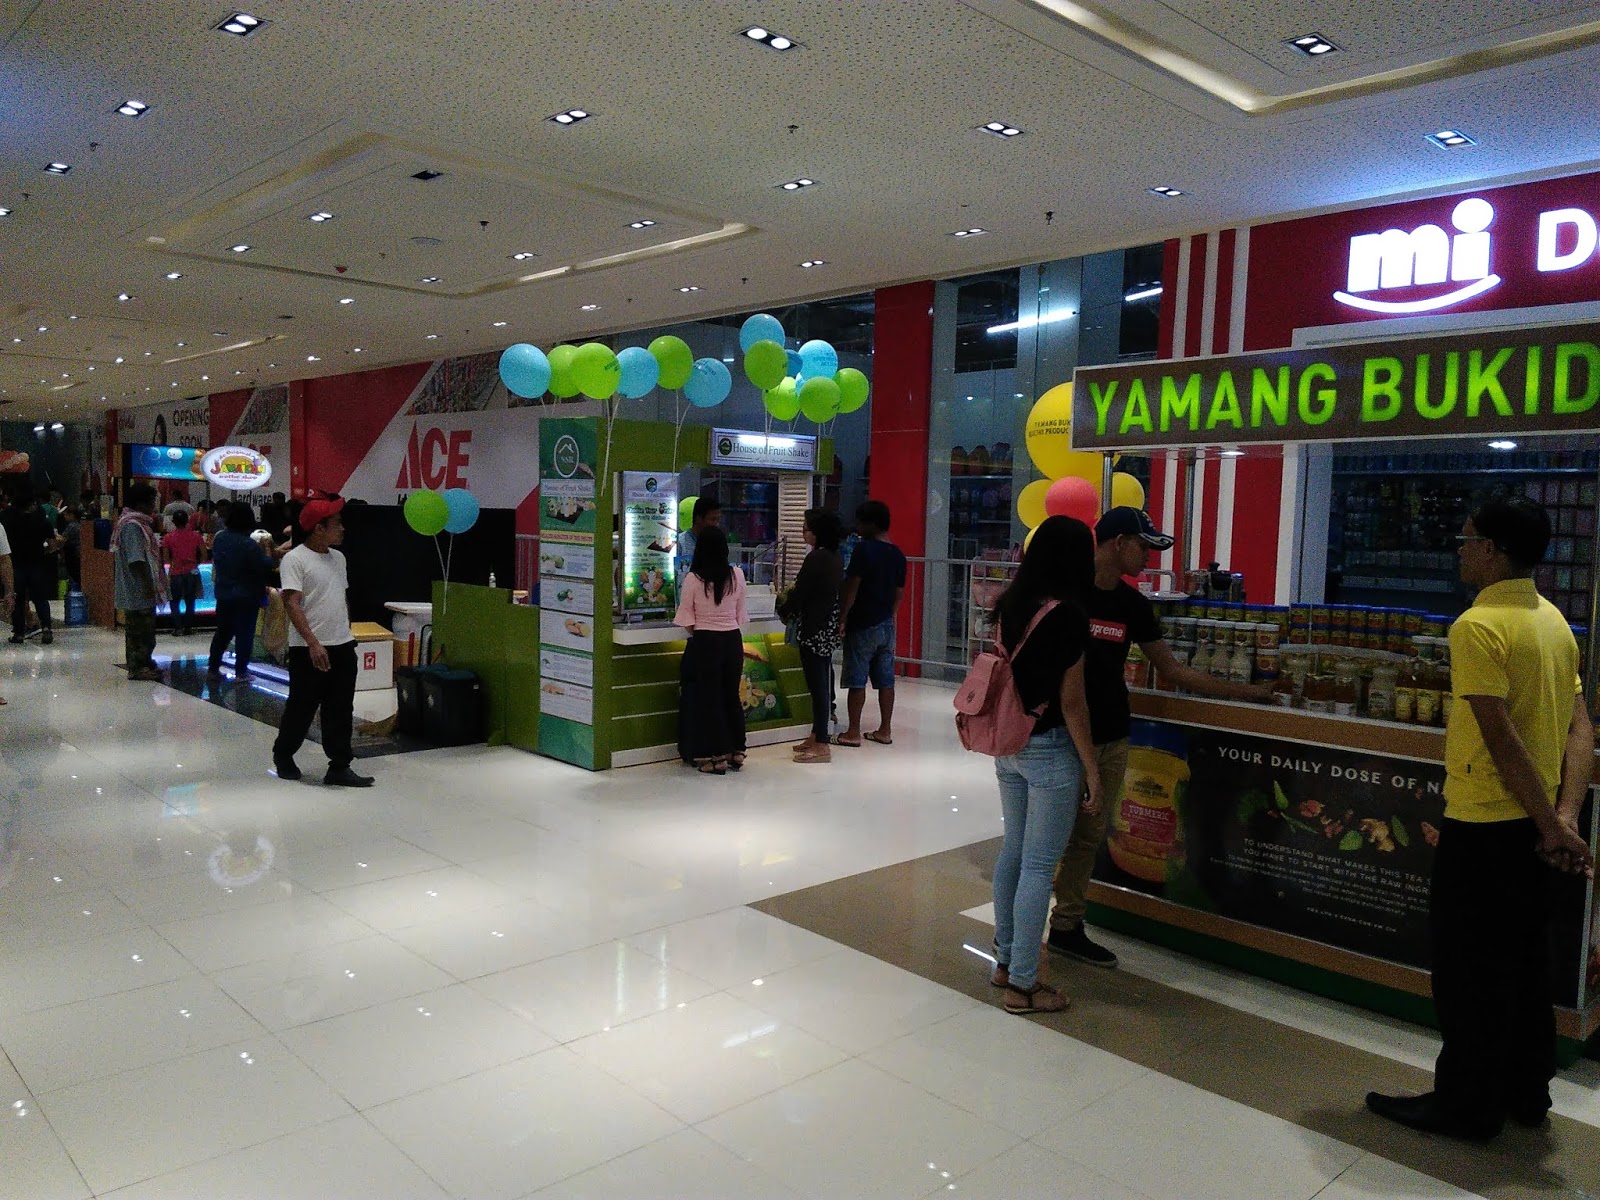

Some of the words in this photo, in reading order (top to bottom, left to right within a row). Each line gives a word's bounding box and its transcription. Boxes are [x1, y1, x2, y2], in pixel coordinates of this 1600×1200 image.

[1347, 197, 1494, 292] mi
[1537, 208, 1600, 272] D
[1089, 361, 1338, 437] YAMANG
[1361, 341, 1600, 424] BUKID
[173, 408, 209, 426] OPENING
[395, 420, 473, 490] ACE
[732, 442, 757, 454] House
[759, 445, 767, 454] of
[769, 445, 786, 456] Fruit
[788, 446, 809, 458] Shake
[237, 490, 273, 505] ardware
[1088, 622, 1124, 639] upreme
[1219, 746, 1262, 765] YOUR
[1270, 755, 1322, 775] DAILY
[1330, 765, 1381, 785] DOSE
[1391, 775, 1416, 790] OF
[1128, 804, 1170, 821] TURMERIC
[1244, 838, 1255, 847] TO
[1257, 841, 1314, 859] UNDERSTAND
[1317, 854, 1341, 864] WHAT
[1345, 860, 1377, 873] MAKES
[1380, 867, 1401, 879] THIS
[1244, 848, 1260, 857] YOU
[1262, 852, 1285, 863] HAVE
[1288, 857, 1299, 866] TO
[1303, 861, 1330, 872] START
[1333, 868, 1357, 879] WITH
[1360, 872, 1378, 884] THE
[1380, 877, 1402, 889] RAW
